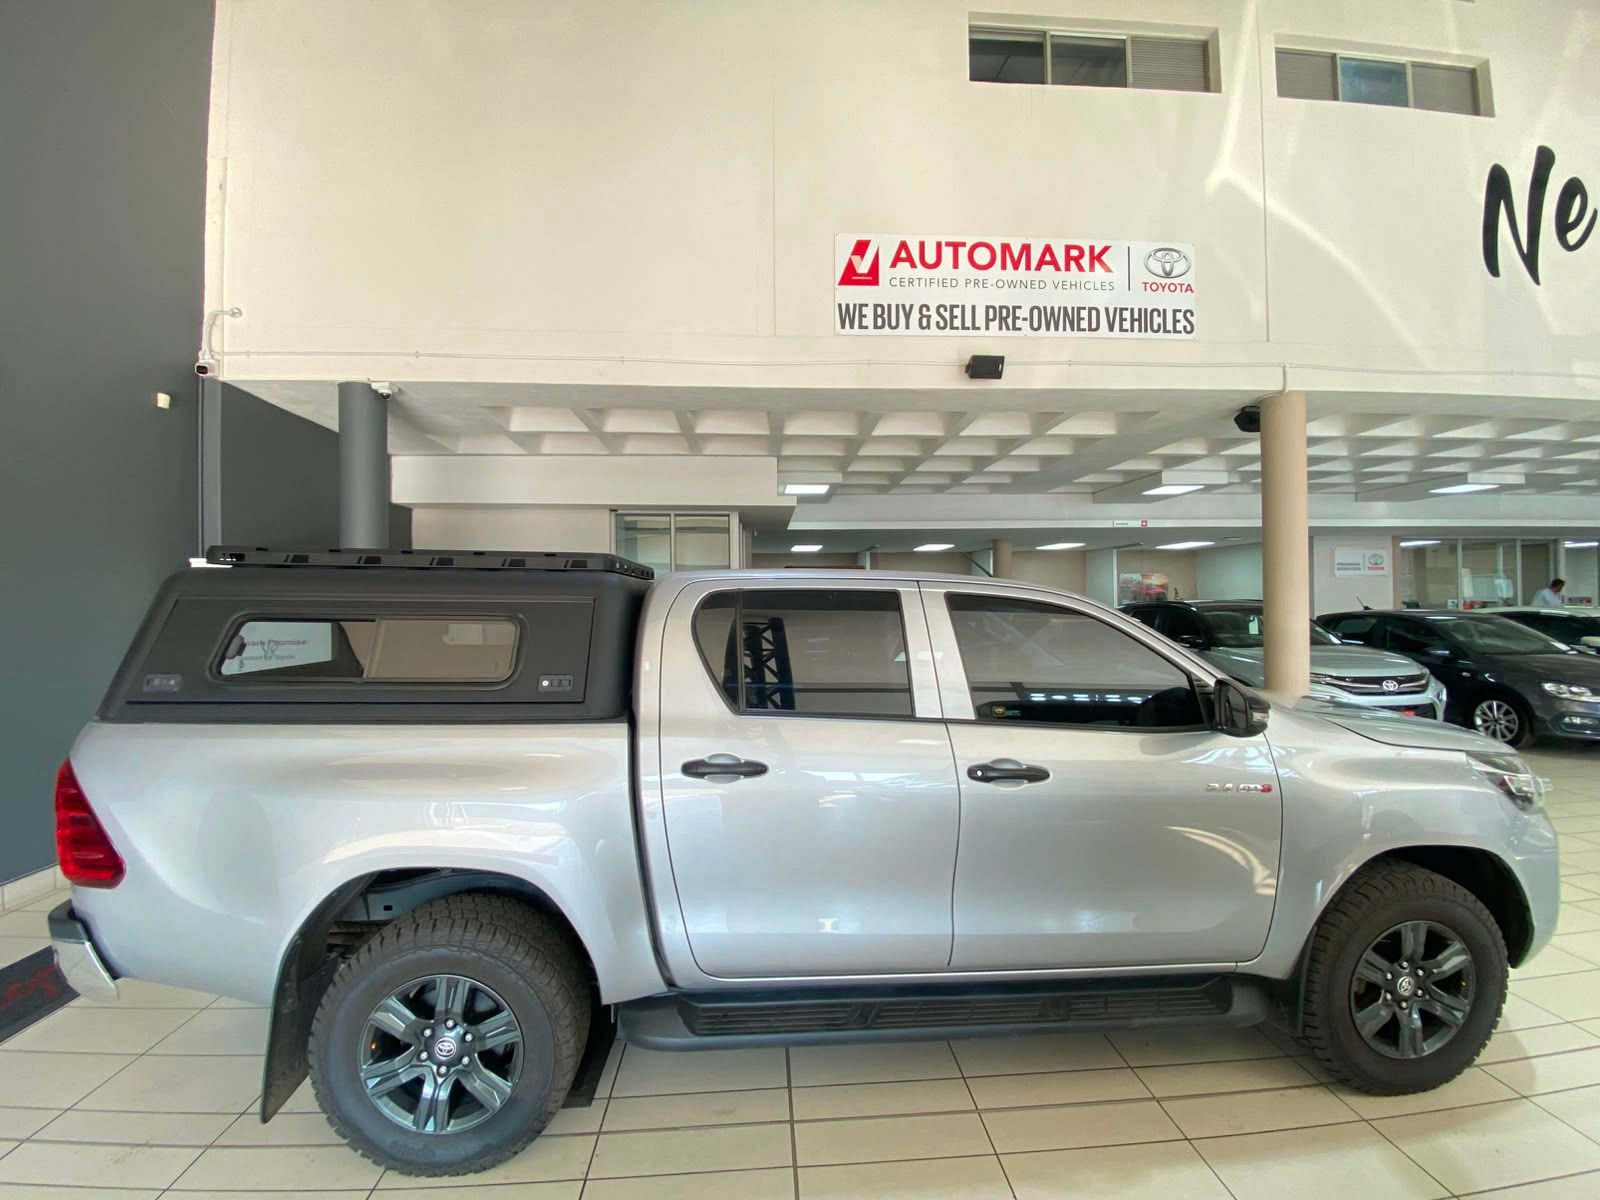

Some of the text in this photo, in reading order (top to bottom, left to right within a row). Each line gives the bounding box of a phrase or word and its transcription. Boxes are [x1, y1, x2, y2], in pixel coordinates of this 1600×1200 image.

[1482, 145, 1598, 286] Ne
[889, 240, 1113, 273] AUTOMARK
[889, 276, 1115, 291] CERTIFIED PRE-OWNED VEHICLES
[1141, 281, 1194, 293] TOYOTA
[837, 303, 1195, 335] WE BUY & SELL PRE-OWNED VEHICLES
